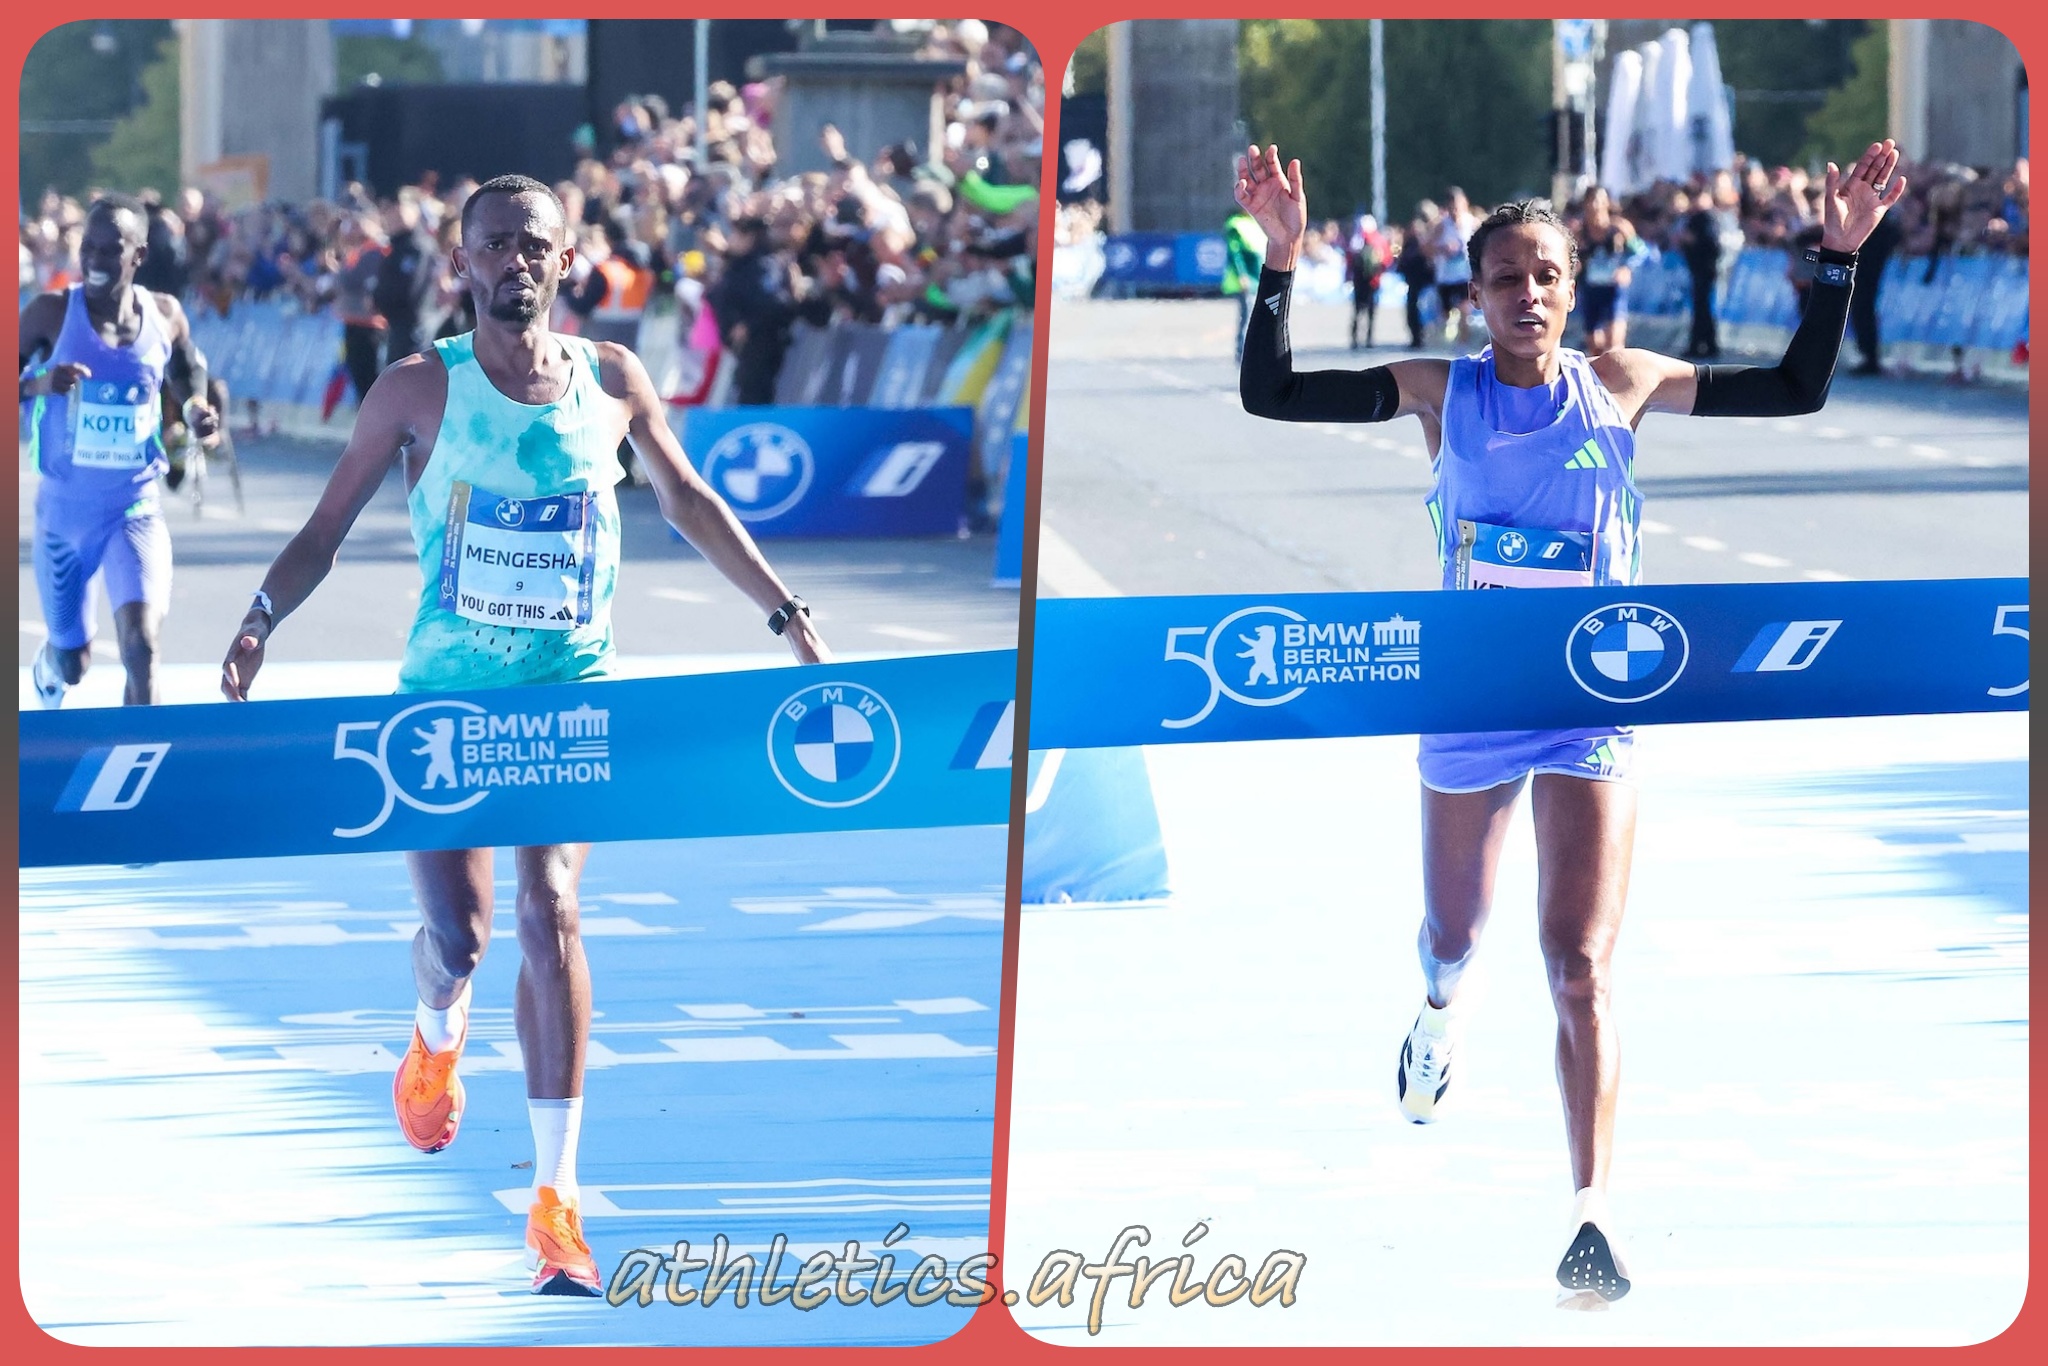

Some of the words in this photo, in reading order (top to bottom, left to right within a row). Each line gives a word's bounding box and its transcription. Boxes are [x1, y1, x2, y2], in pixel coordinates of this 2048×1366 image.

[466, 544, 577, 570] MENGESHA
[515, 580, 524, 591] 9
[461, 594, 485, 612] YOU
[488, 602, 513, 618] GOT
[515, 604, 546, 620] THIS
[1283, 622, 1369, 647] BMW
[1583, 608, 1672, 636] BMW
[1283, 647, 1370, 665] BERLIN
[1283, 663, 1420, 684] MARATHON
[785, 687, 882, 722] BMW
[461, 712, 554, 742] BMW
[462, 740, 556, 764] BERLIN
[463, 762, 611, 788] MARATHON
